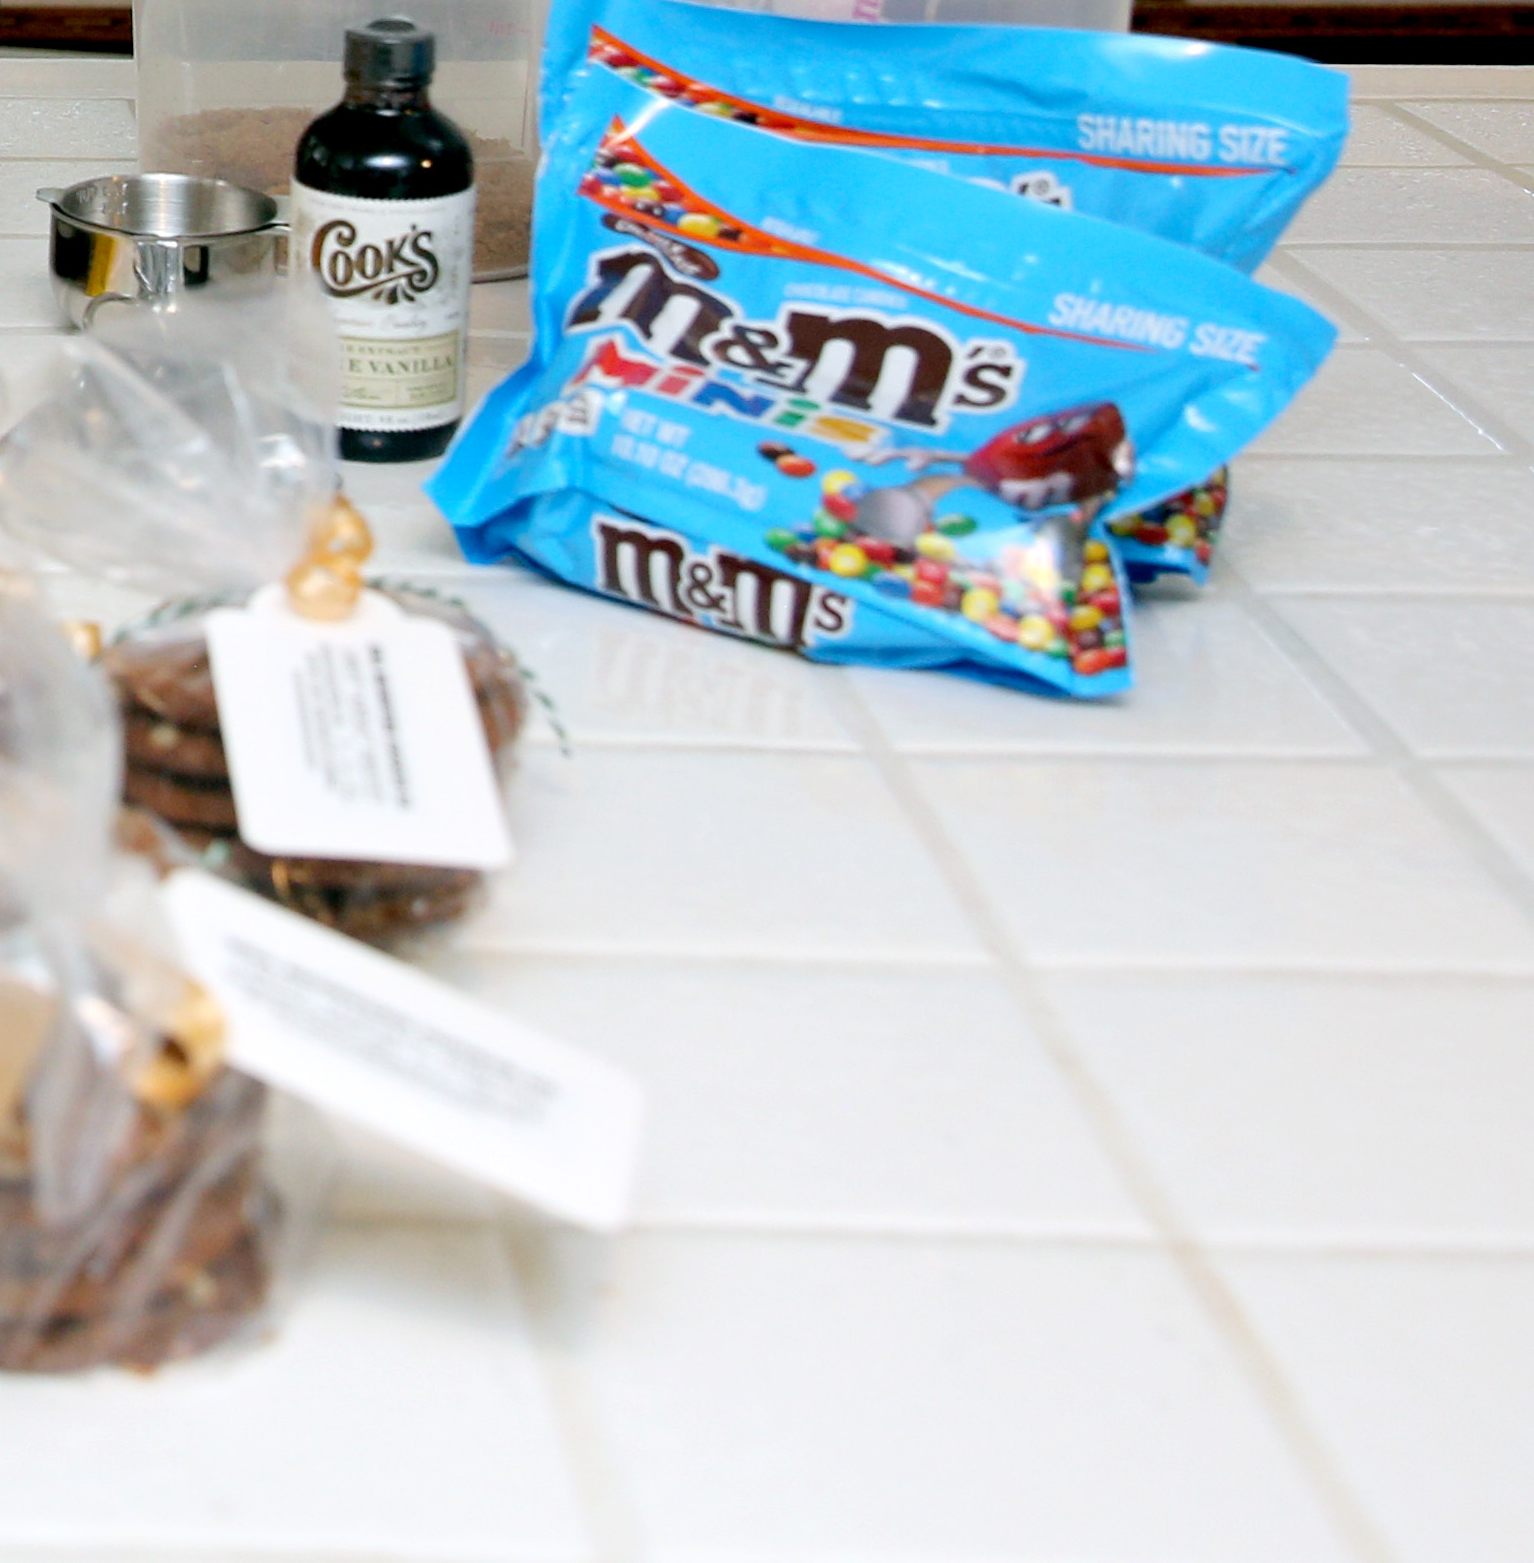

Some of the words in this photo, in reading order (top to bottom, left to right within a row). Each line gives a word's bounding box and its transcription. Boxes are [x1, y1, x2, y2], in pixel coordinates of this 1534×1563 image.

[1077, 113, 1212, 161] SHARING
[1218, 124, 1289, 166] SIZE
[1048, 292, 1189, 350] SHARING
[1190, 322, 1269, 365] SIZE
